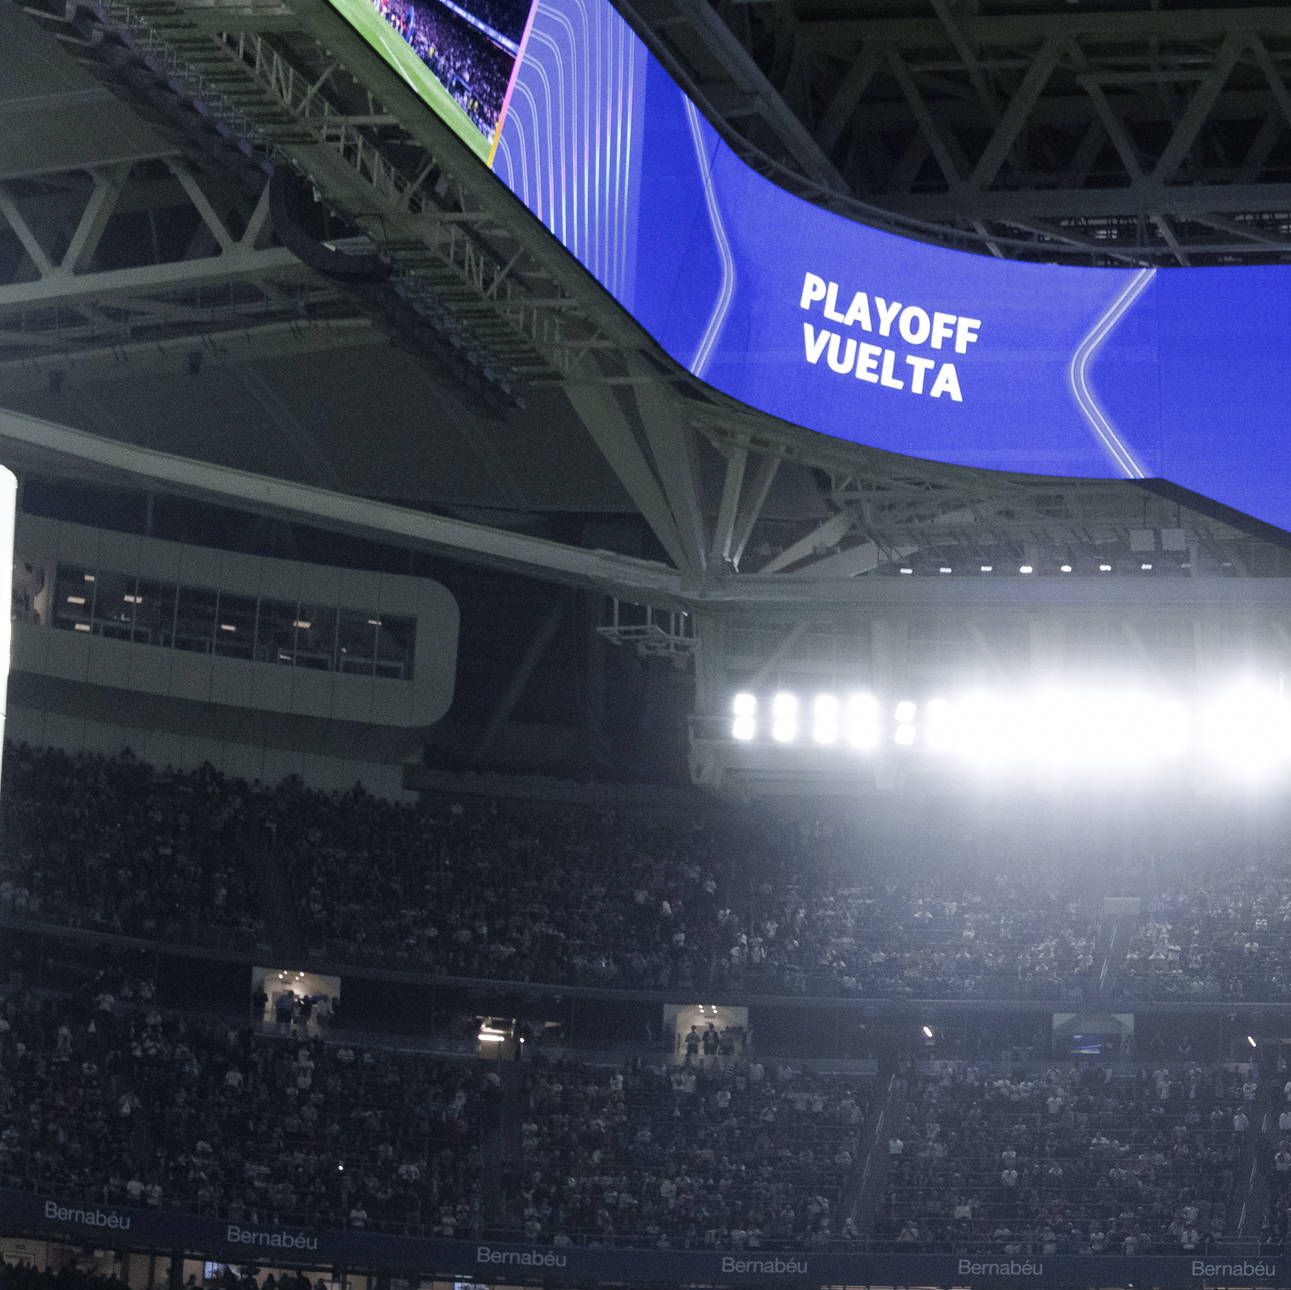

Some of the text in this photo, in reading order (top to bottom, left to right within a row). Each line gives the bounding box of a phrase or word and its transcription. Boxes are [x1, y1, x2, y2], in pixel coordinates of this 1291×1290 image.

[799, 271, 982, 354] PLAYOFF
[803, 321, 963, 402] VUELTA
[44, 1201, 131, 1231] Bernabéu
[227, 1225, 318, 1251] Bernabéu
[476, 1246, 567, 1268] Bernabéu
[721, 1256, 808, 1275] Bernabéu
[957, 1258, 1044, 1277] Bernabéu
[1191, 1259, 1276, 1278] Bernabéu
